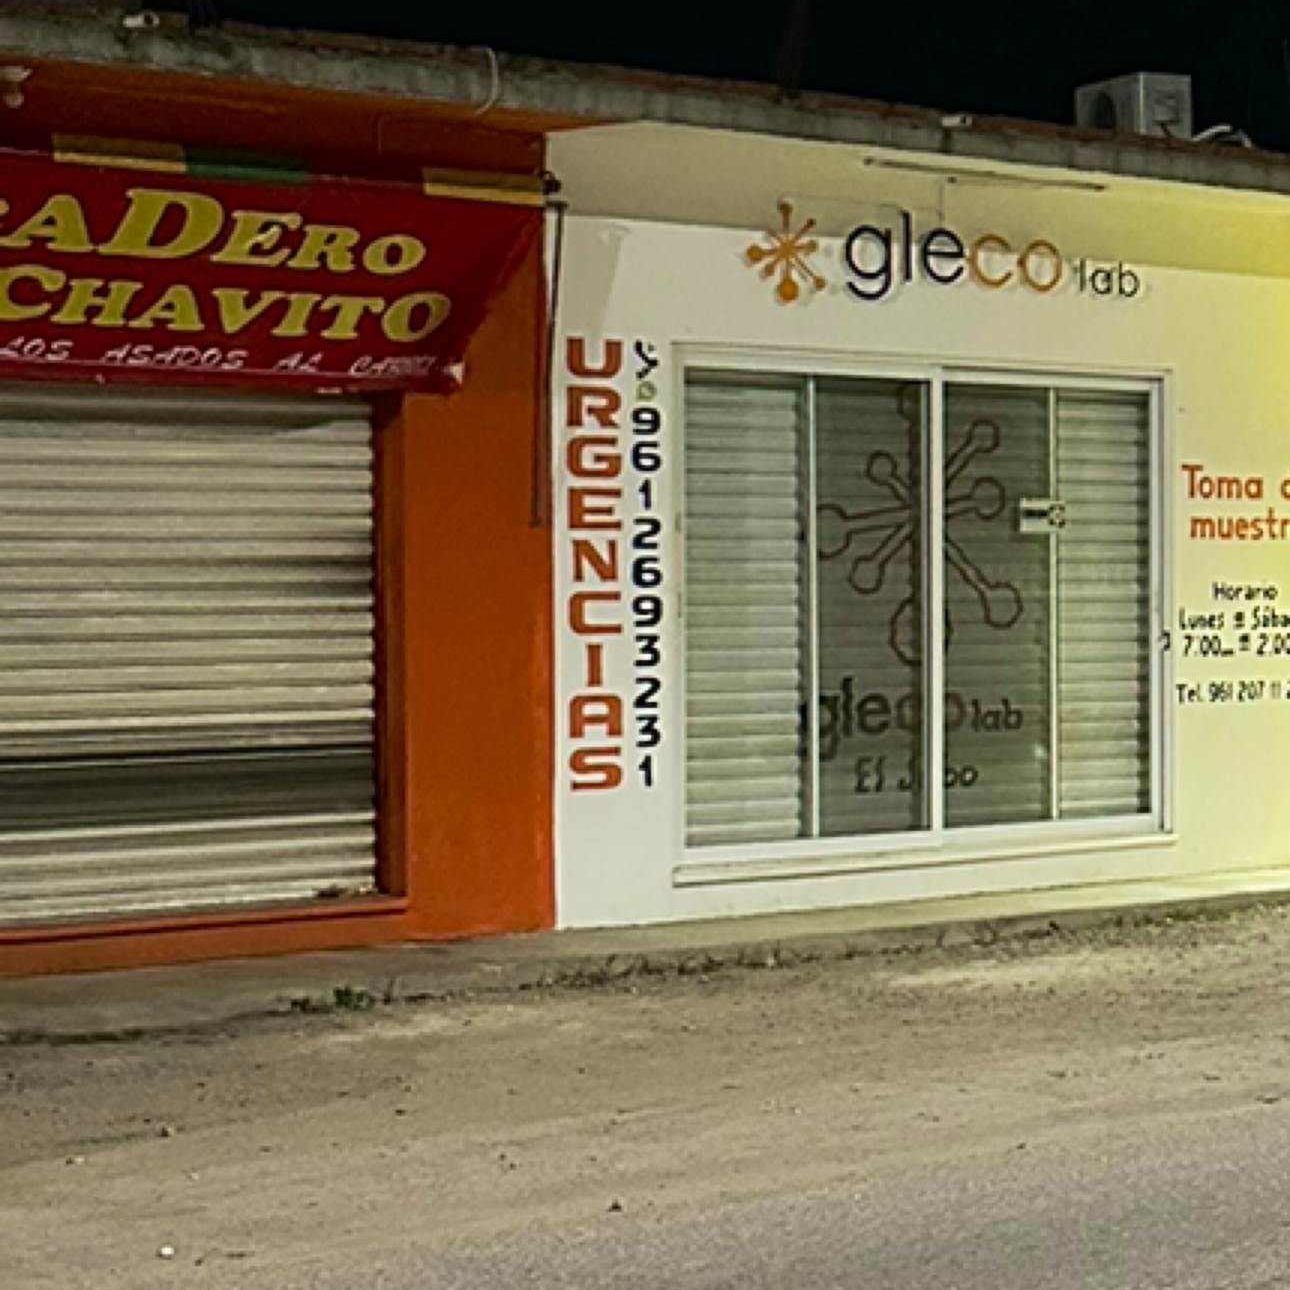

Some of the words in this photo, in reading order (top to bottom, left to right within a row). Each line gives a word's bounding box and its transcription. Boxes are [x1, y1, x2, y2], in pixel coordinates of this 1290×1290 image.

[0, 187, 427, 274] ADERO
[845, 209, 1063, 301] gleco
[1078, 258, 1140, 298] lab
[0, 264, 452, 343] CHAVITO
[101, 343, 248, 371] ASADOS
[1181, 464, 1263, 500] Toma
[565, 336, 624, 792] URGENCIAS
[1212, 581, 1279, 601] Horario
[631, 407, 662, 787] 9612693231
[971, 698, 1024, 733] lab
[896, 753, 979, 791] Jbo
